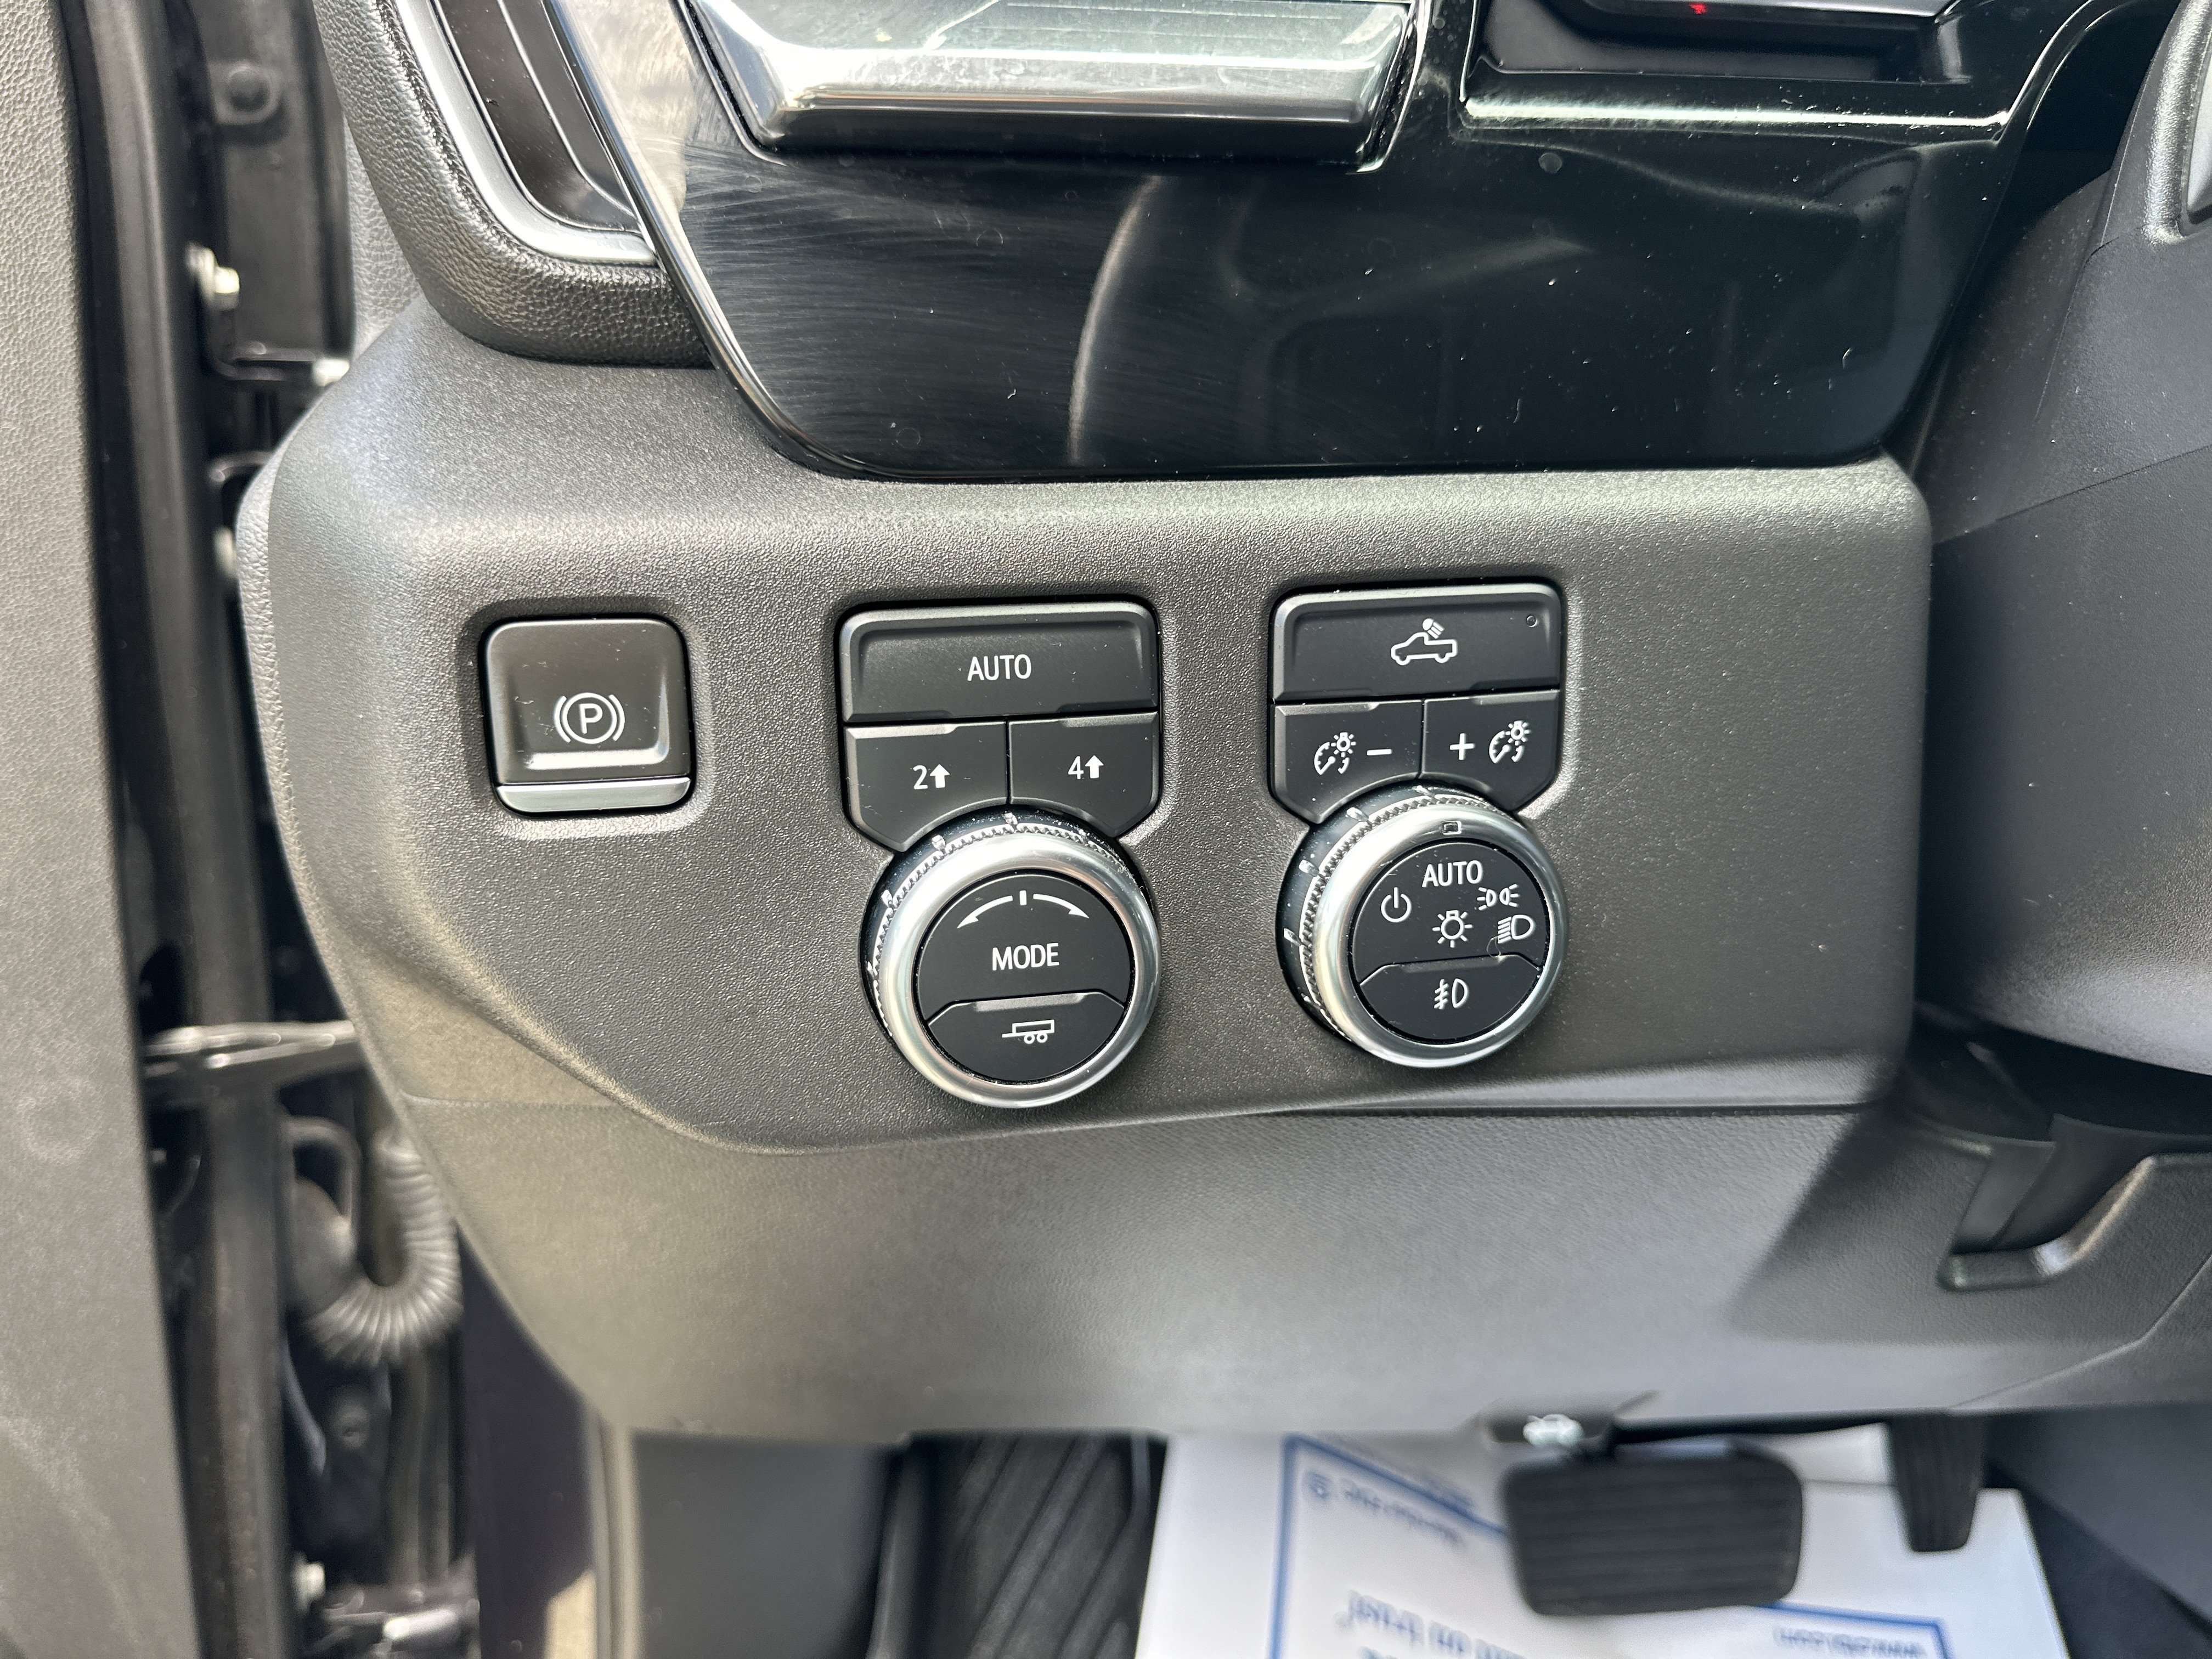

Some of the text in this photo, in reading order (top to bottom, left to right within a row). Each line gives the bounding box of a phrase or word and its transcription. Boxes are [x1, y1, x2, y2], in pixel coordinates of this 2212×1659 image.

[967, 654, 1032, 681] AUTO
[912, 765, 928, 790] 2
[1068, 755, 1084, 780] 4
[1421, 860, 1483, 888] AUTO
[992, 943, 1060, 971] MODE
